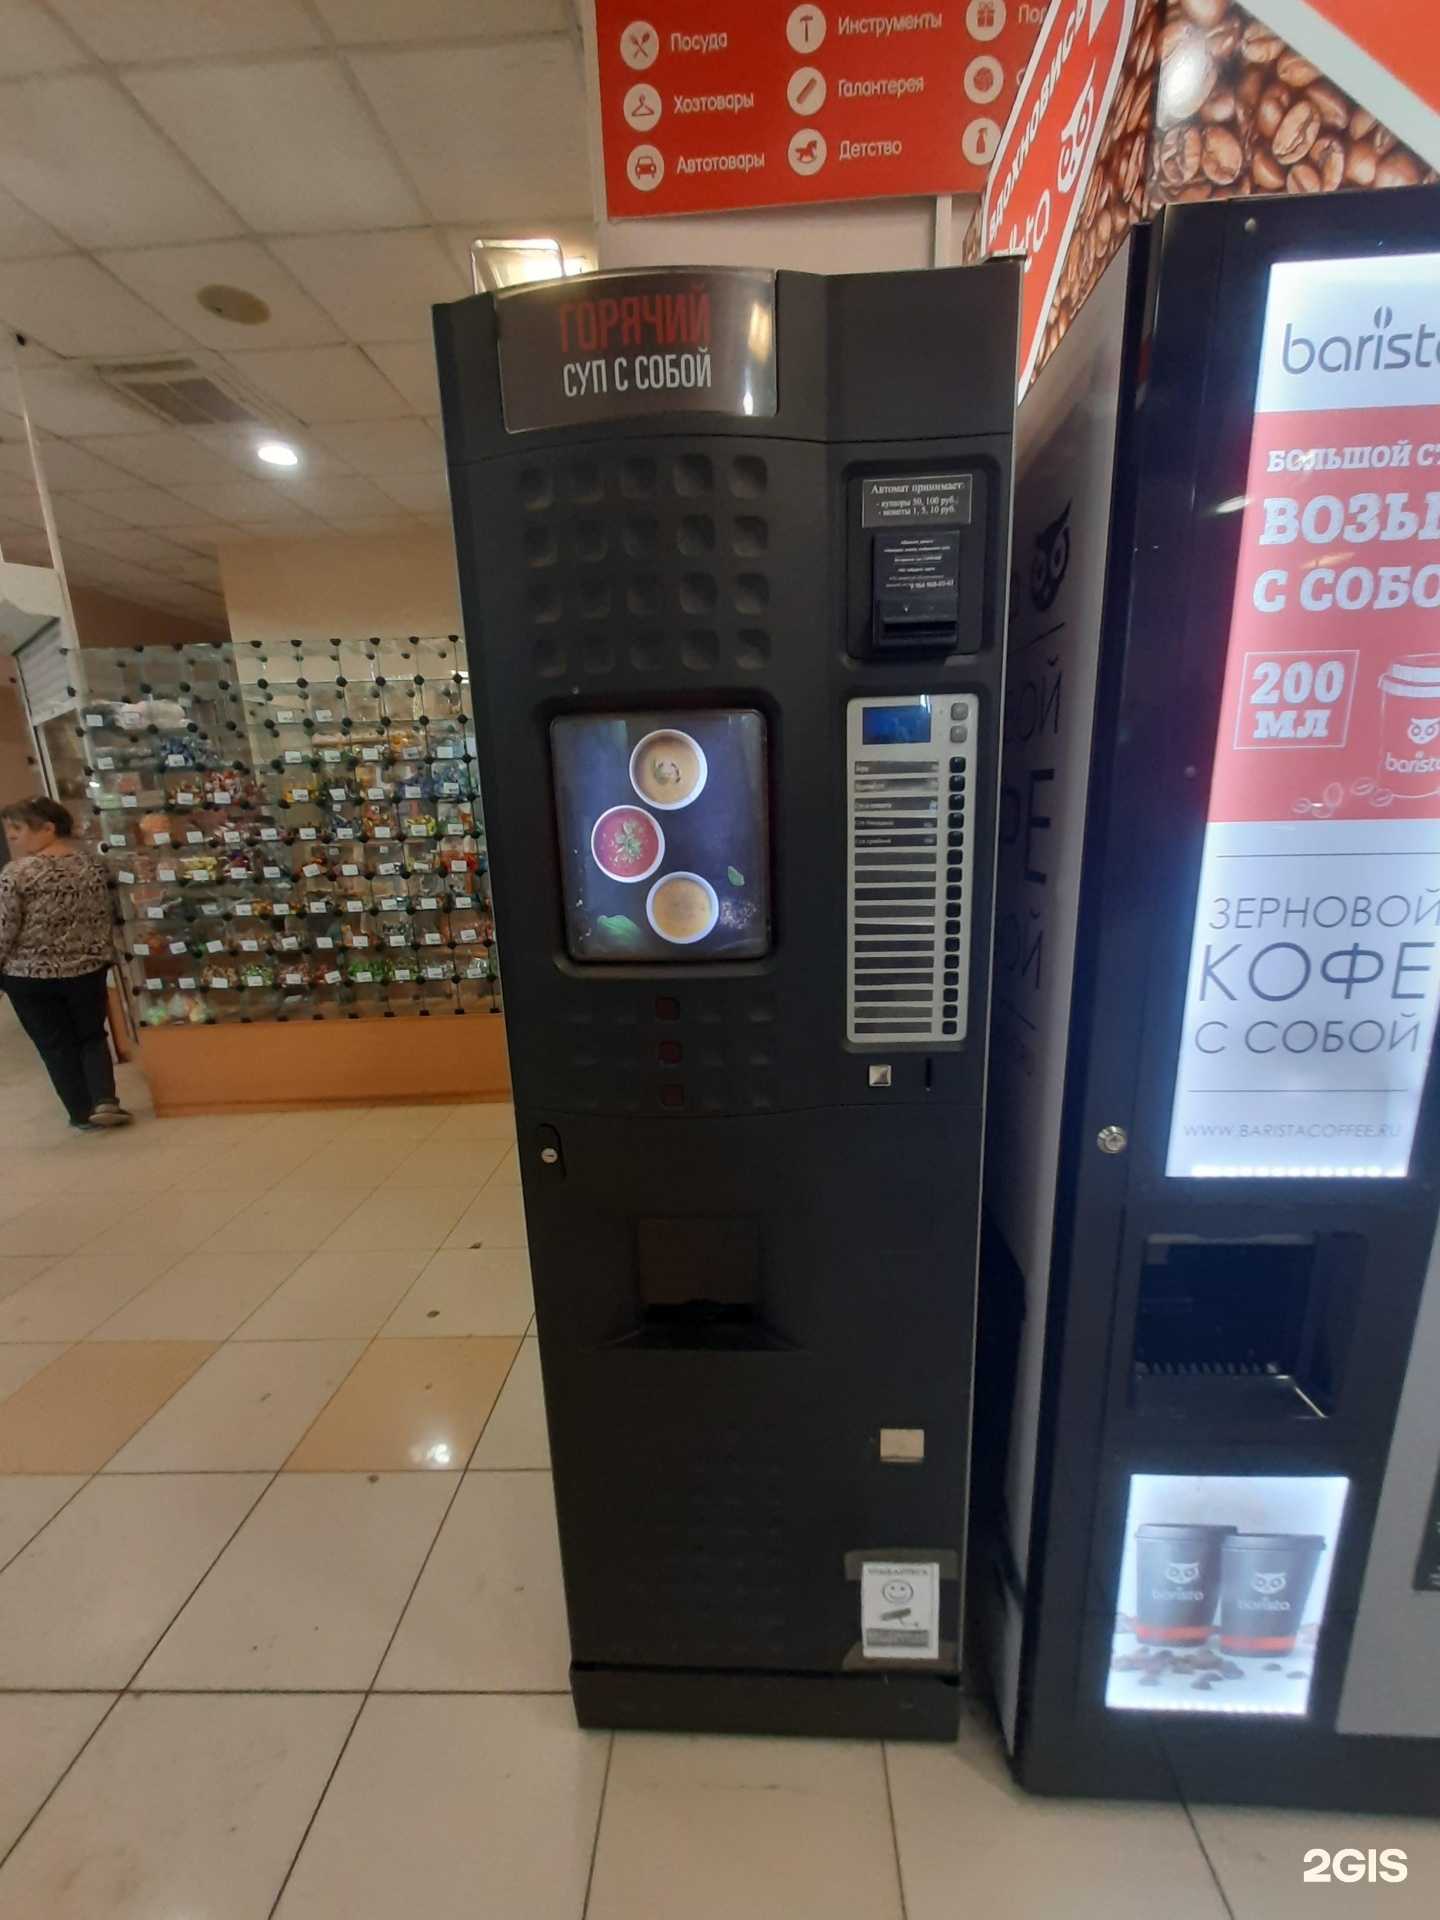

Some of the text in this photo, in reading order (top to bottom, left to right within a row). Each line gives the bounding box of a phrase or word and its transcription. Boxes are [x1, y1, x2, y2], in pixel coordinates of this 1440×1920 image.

[670, 32, 728, 53] Посуда
[838, 10, 943, 36] Инструменты
[673, 91, 755, 114] Хозтовары
[838, 76, 925, 97] Галантерея
[676, 153, 766, 175] Автотовары
[839, 138, 903, 160] Детство
[559, 283, 712, 353] ГОРЯЧИЙ
[1281, 305, 1440, 375] barist
[563, 346, 712, 398] СУП С СОБОЙ
[1267, 440, 1410, 473] БОЛЬШОЙ
[1253, 568, 1289, 613] С
[1250, 660, 1345, 704] 200
[1208, 888, 1440, 929] ЗЕРНОВОЙ
[1199, 941, 1436, 1002] КОФЕ
[1194, 1012, 1421, 1054] С СОБОЙ
